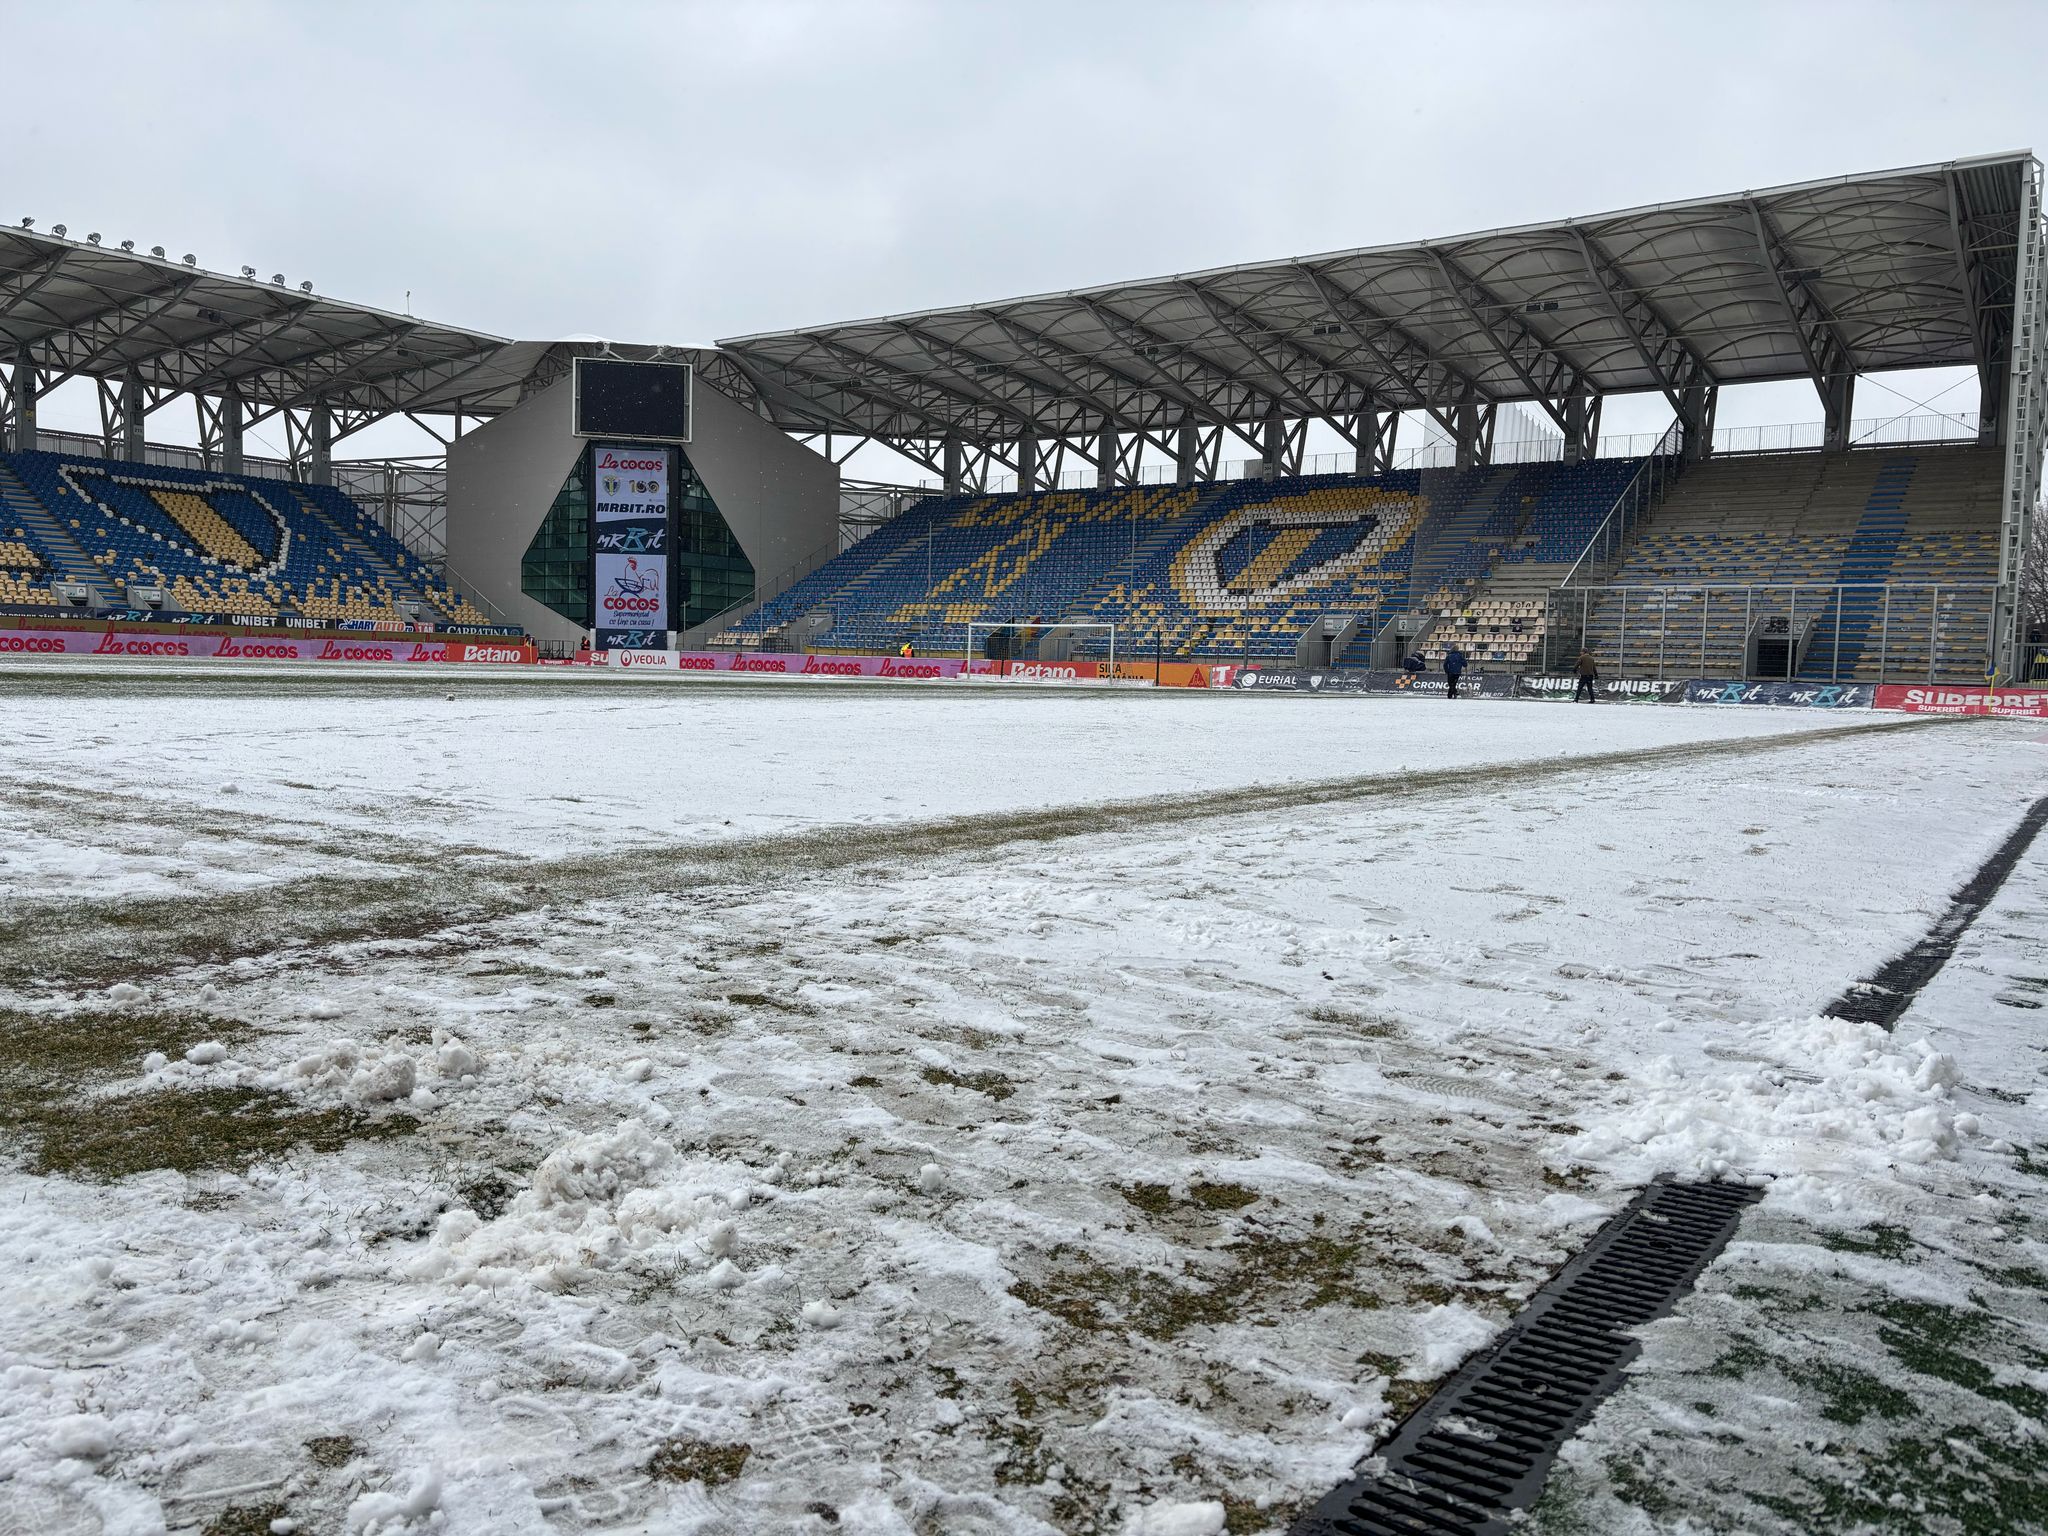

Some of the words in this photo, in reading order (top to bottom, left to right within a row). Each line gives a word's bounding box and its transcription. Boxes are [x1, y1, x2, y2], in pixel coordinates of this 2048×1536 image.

[598, 453, 619, 469] La
[597, 503, 666, 514] MRBIT.RO
[231, 615, 277, 627] UNIBET
[286, 617, 328, 629] UNIBET
[92, 632, 125, 655] La
[212, 637, 241, 657] La
[317, 640, 342, 660] La
[464, 645, 520, 662] Betano
[633, 654, 667, 665] VEOLIA
[730, 652, 747, 671] La
[801, 655, 820, 674] La
[876, 658, 896, 677] La
[1010, 662, 1076, 678] Betano
[1608, 680, 1675, 693] UNIBET
[1918, 704, 1967, 713] SUPERBET
[1991, 706, 2041, 715] SUPERBET
